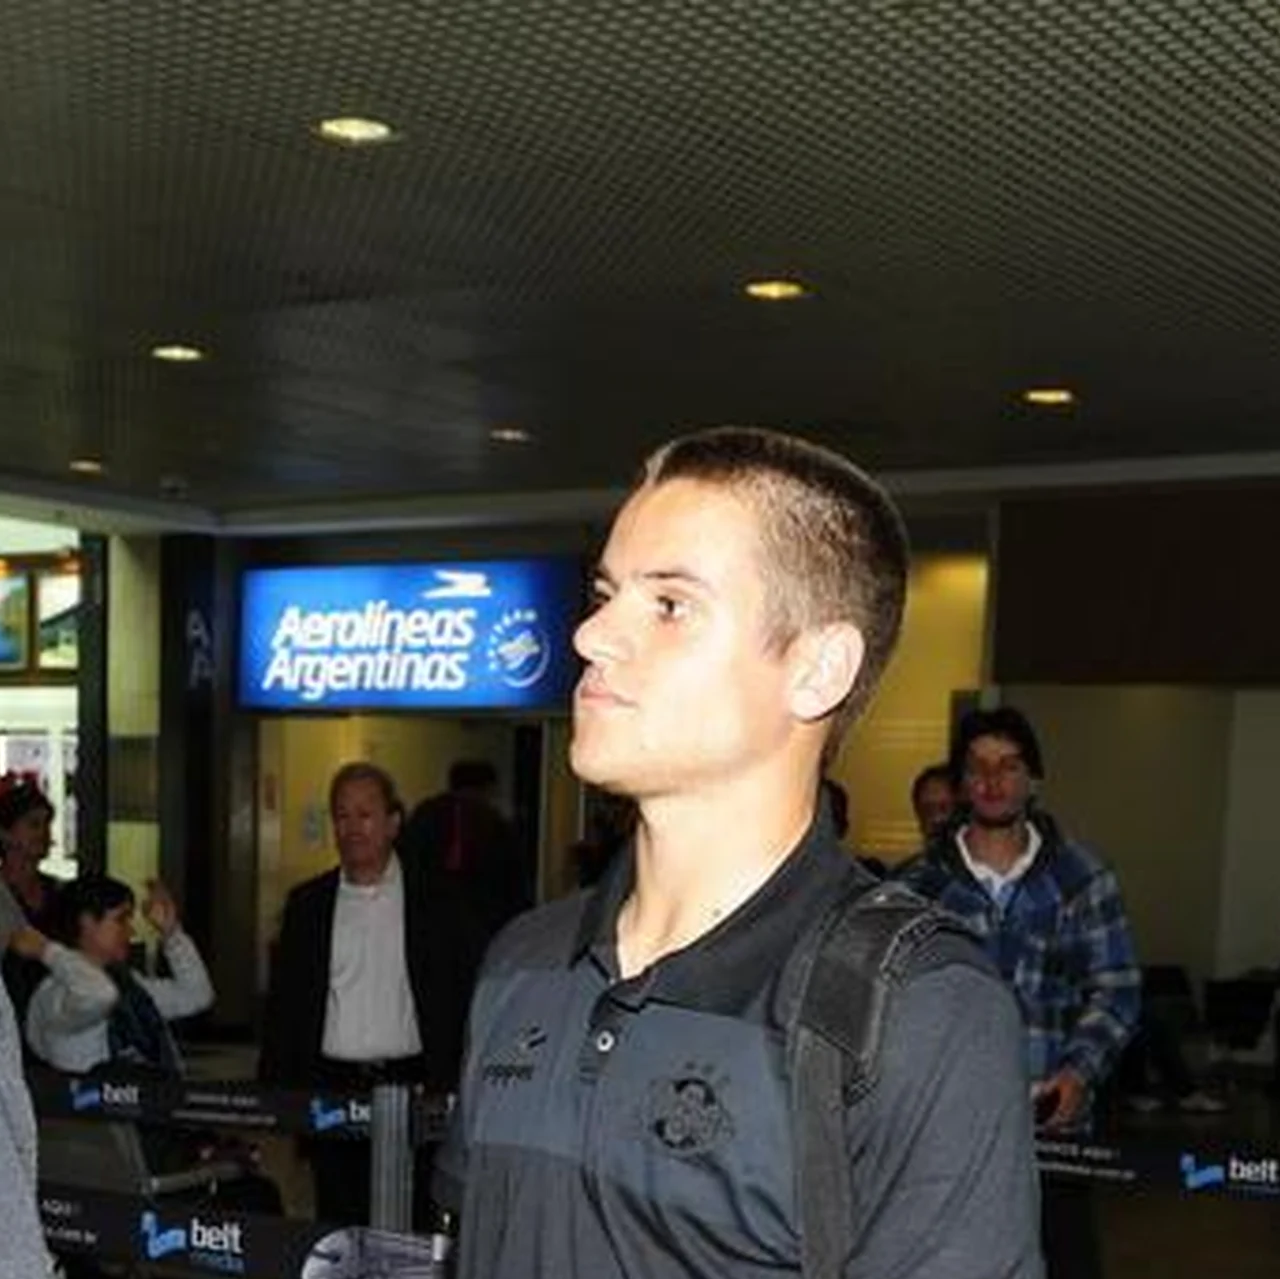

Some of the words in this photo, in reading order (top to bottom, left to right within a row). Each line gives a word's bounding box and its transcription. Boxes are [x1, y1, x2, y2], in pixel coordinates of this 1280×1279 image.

[271, 599, 477, 651] Aerolíneas
[261, 649, 470, 701] Argentinas
[1228, 1154, 1279, 1183] belt
[190, 1216, 243, 1254] belt
